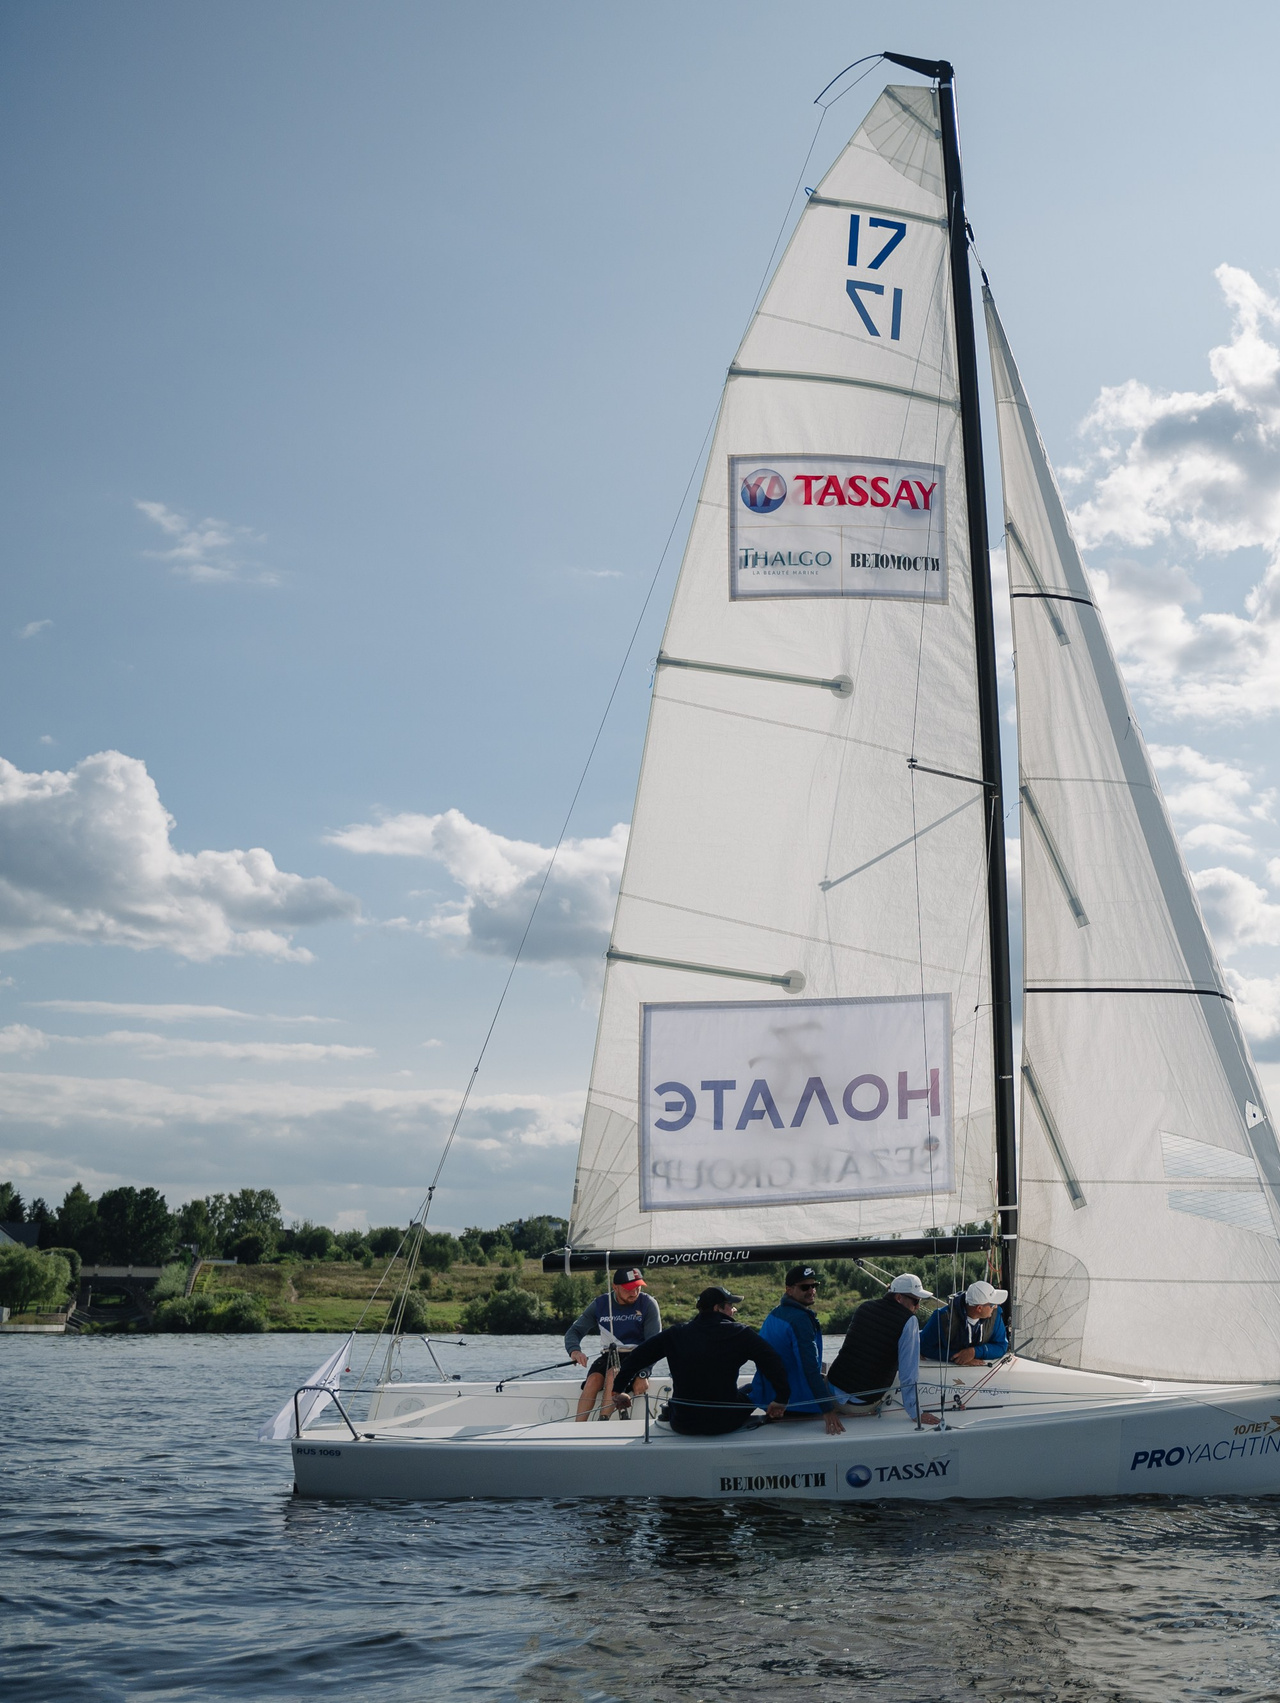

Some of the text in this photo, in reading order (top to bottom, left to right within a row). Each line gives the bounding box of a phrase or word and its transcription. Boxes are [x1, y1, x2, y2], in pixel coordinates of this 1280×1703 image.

[847, 214, 907, 270] 17
[793, 474, 938, 511] TASSAY
[850, 552, 940, 572] ВЕДОМОСТИ
[653, 1068, 941, 1132] ЭТАЛОН
[646, 1249, 750, 1267] pro-yachting.ru
[296, 1447, 342, 1457] RUS 1069
[874, 1459, 951, 1483] TASSAY
[719, 1472, 826, 1493] ВЕДОМОСТИ
